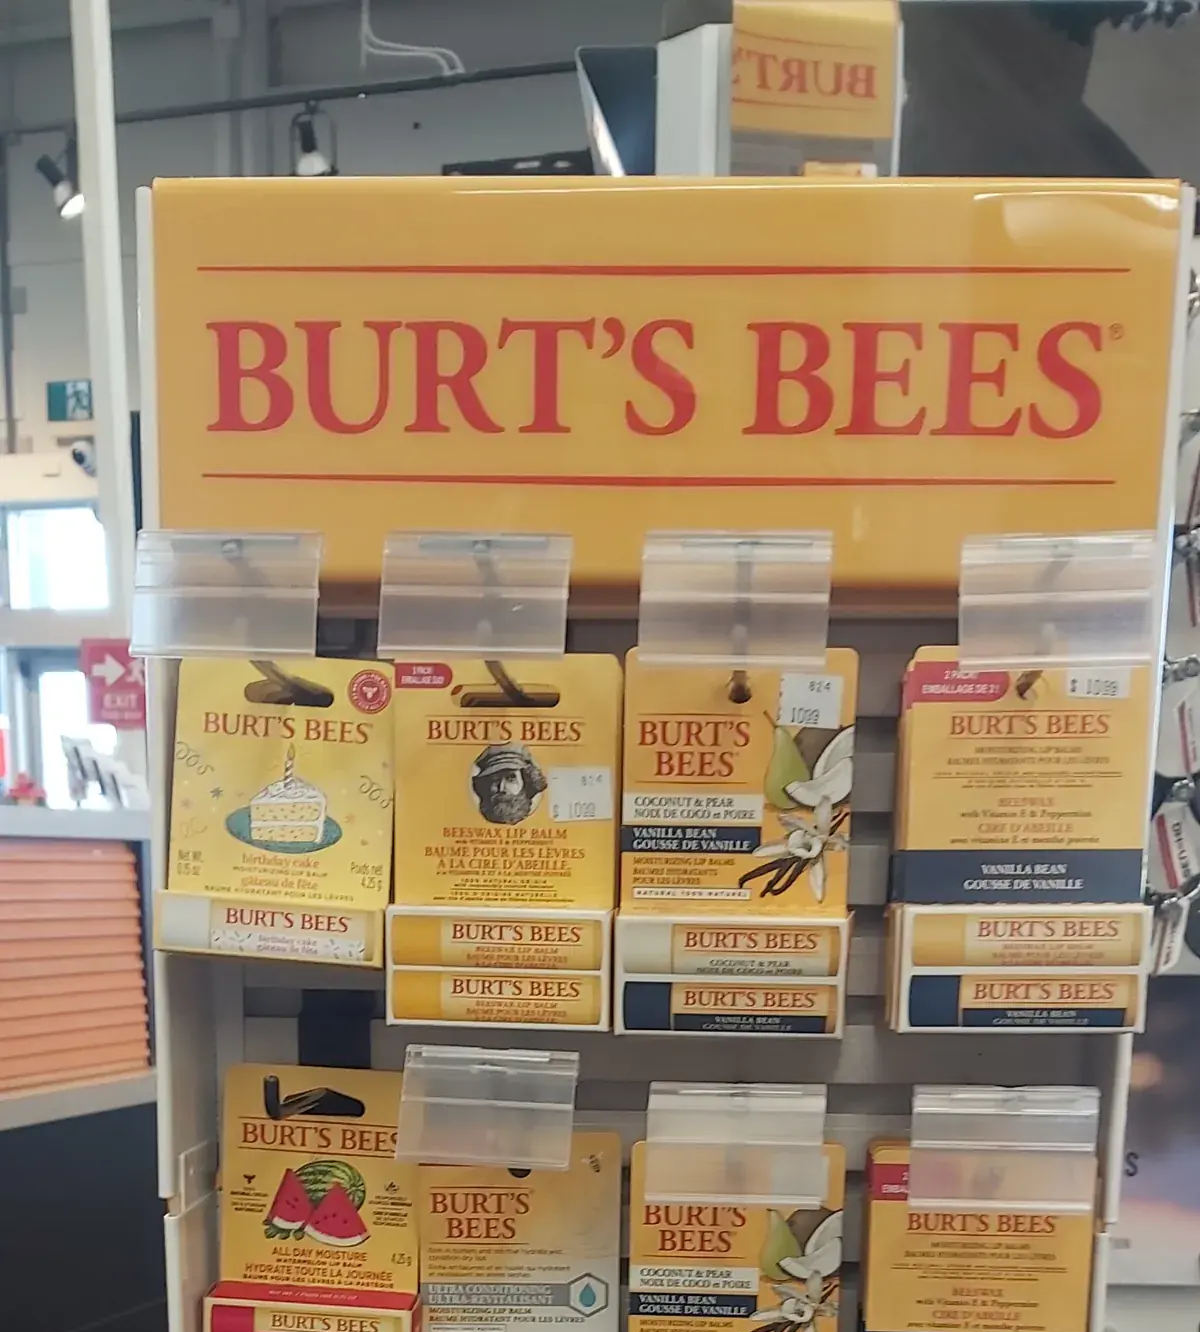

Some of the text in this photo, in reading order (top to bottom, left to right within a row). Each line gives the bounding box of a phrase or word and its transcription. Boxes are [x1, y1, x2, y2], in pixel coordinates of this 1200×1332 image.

[206, 316, 1104, 440] BURT'S BEES
[204, 712, 369, 744] BURT'S BEES
[427, 720, 581, 742] BURT'S BEES
[950, 714, 1110, 735] BURT'S BEES
[638, 721, 750, 748] BURT'S
[655, 751, 734, 777] BEES
[634, 797, 734, 808] COCONUT & PEAR
[443, 827, 567, 839] BEESWAX LIP BALM
[632, 828, 717, 839] VANILLA BEAN
[632, 839, 750, 851] GOUSSE DE VANILLE
[242, 853, 320, 869] birthday cake
[981, 864, 1068, 875] VANILLA BEAN
[963, 879, 1084, 890] GOUSSE DE VANILLE
[226, 907, 349, 933] BURT'S BEES
[452, 924, 581, 943] BURT'S BEES
[978, 921, 1119, 937] BURT'S BEES
[684, 932, 817, 949] BURT'S BEES
[452, 979, 580, 997] BURT'S BEES
[973, 984, 1115, 1000] BURT'S BEES
[683, 990, 815, 1008] BURT'S BEES
[430, 1192, 530, 1214] BURT'S
[642, 1205, 747, 1228] BURT'S
[446, 1217, 516, 1239] BEES
[658, 1230, 732, 1253] BEES
[272, 1247, 367, 1261] ALL DAY MOISTURE
[245, 1263, 393, 1281] HYDRATE TOUTE LA JOURNÉE
[640, 1268, 733, 1278] COCONUT & PEAR
[428, 1284, 551, 1295] ULTRA CONDITIONING
[639, 1295, 717, 1304] VANILLA BEAN
[639, 1304, 748, 1316] GOUSSE DE VANILLE
[271, 1315, 331, 1330] BURT'S
